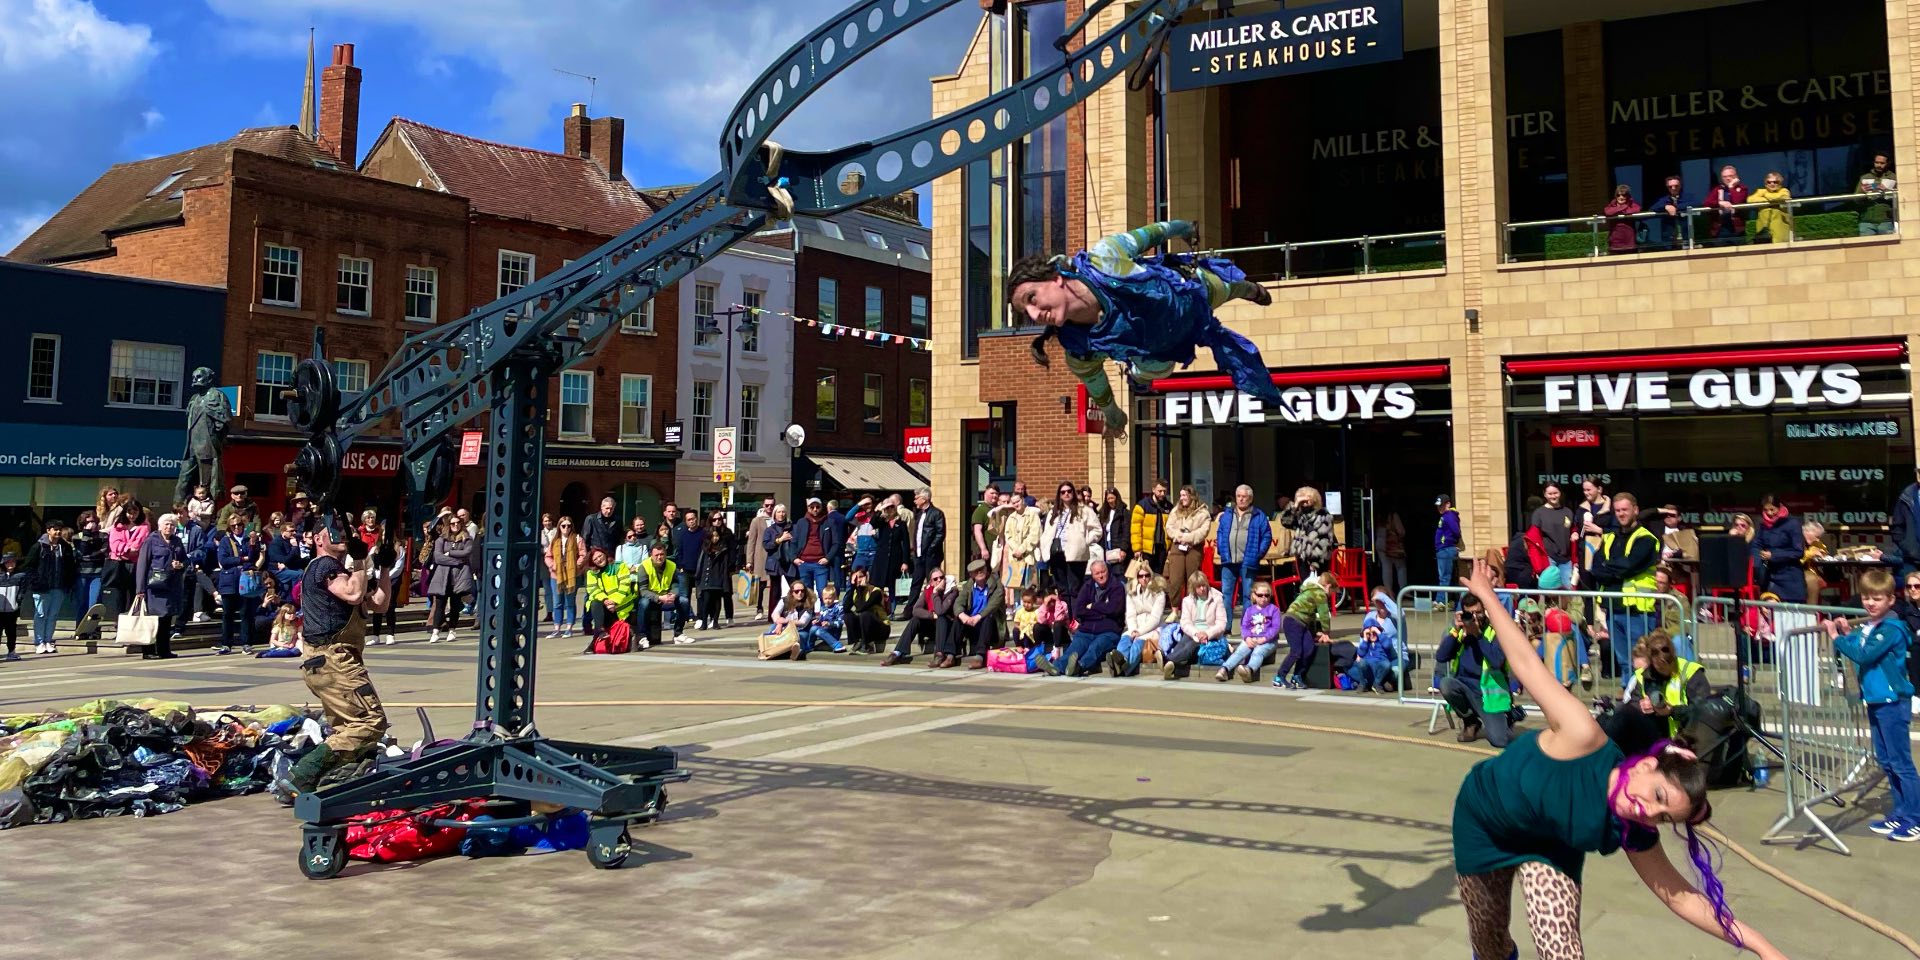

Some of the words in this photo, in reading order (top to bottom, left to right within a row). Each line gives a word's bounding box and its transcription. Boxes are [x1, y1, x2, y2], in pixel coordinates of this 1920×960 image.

[1189, 23, 1266, 51] MILLER
[1270, 20, 1289, 40] &
[1292, 6, 1379, 36] CARTER
[1210, 36, 1356, 74] STEAKHOUSE
[1610, 89, 1728, 124] MILLER
[1740, 85, 1767, 109] &
[1777, 70, 1890, 105] CARTE
[1644, 110, 1881, 156] STEAKHOUSE
[1311, 128, 1410, 161] MILLER
[1416, 125, 1440, 149] &
[1545, 371, 1671, 413] FIVE
[1689, 363, 1862, 409] GUYS
[1165, 390, 1265, 426] FIVE
[1280, 382, 1416, 423] GUYS
[1555, 430, 1595, 443] OPEN
[1786, 422, 1899, 438] MILKSHAKES
[909, 436, 930, 446] FIVE
[906, 445, 931, 454] GUYS
[20, 452, 56, 466] clark
[59, 453, 124, 471] rickerbys
[544, 458, 568, 466] FRESH
[569, 459, 610, 467] HANDMADE
[610, 459, 650, 468] COSMETICS
[1538, 474, 1569, 485] FIVE
[1664, 472, 1698, 483] FIVE
[1700, 471, 1744, 482] GUYS
[1799, 469, 1837, 481] FIVE
[1839, 468, 1885, 481] GUYS
[1802, 512, 1839, 523] FIVE
[1842, 511, 1888, 523] GUYS
